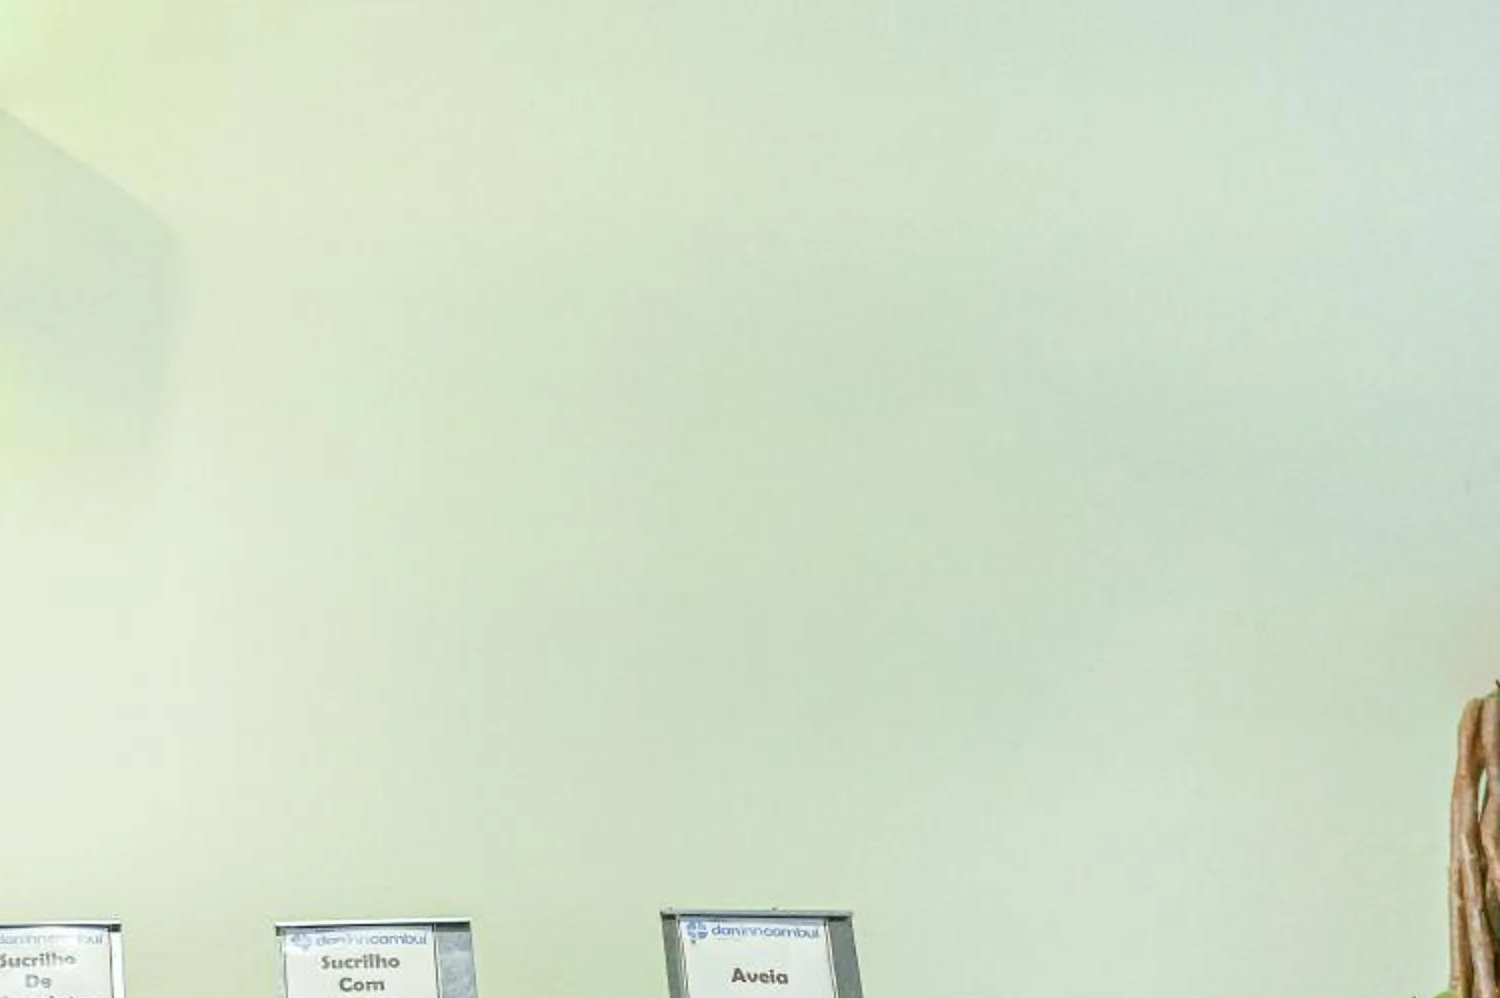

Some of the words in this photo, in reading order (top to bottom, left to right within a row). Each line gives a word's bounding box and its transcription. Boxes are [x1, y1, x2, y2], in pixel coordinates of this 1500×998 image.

[0, 952, 77, 968] Sucrilho
[321, 954, 401, 969] Sucrilho
[25, 974, 52, 988] De
[731, 967, 790, 985] Aveia
[339, 977, 386, 992] Com
